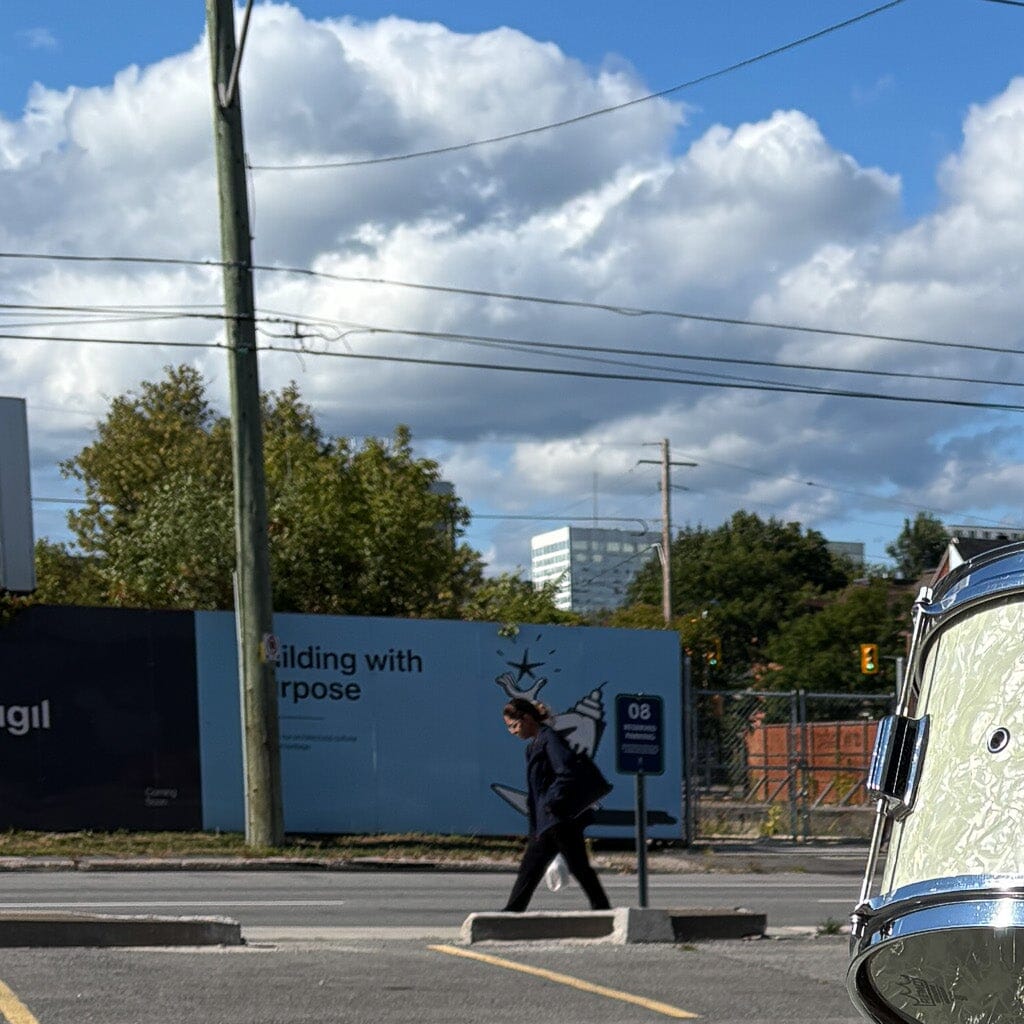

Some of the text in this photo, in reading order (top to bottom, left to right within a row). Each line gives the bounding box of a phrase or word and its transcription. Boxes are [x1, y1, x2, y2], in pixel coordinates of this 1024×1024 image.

[276, 645, 423, 675] ilding with
[278, 680, 361, 704] rpose
[627, 702, 652, 720] 08
